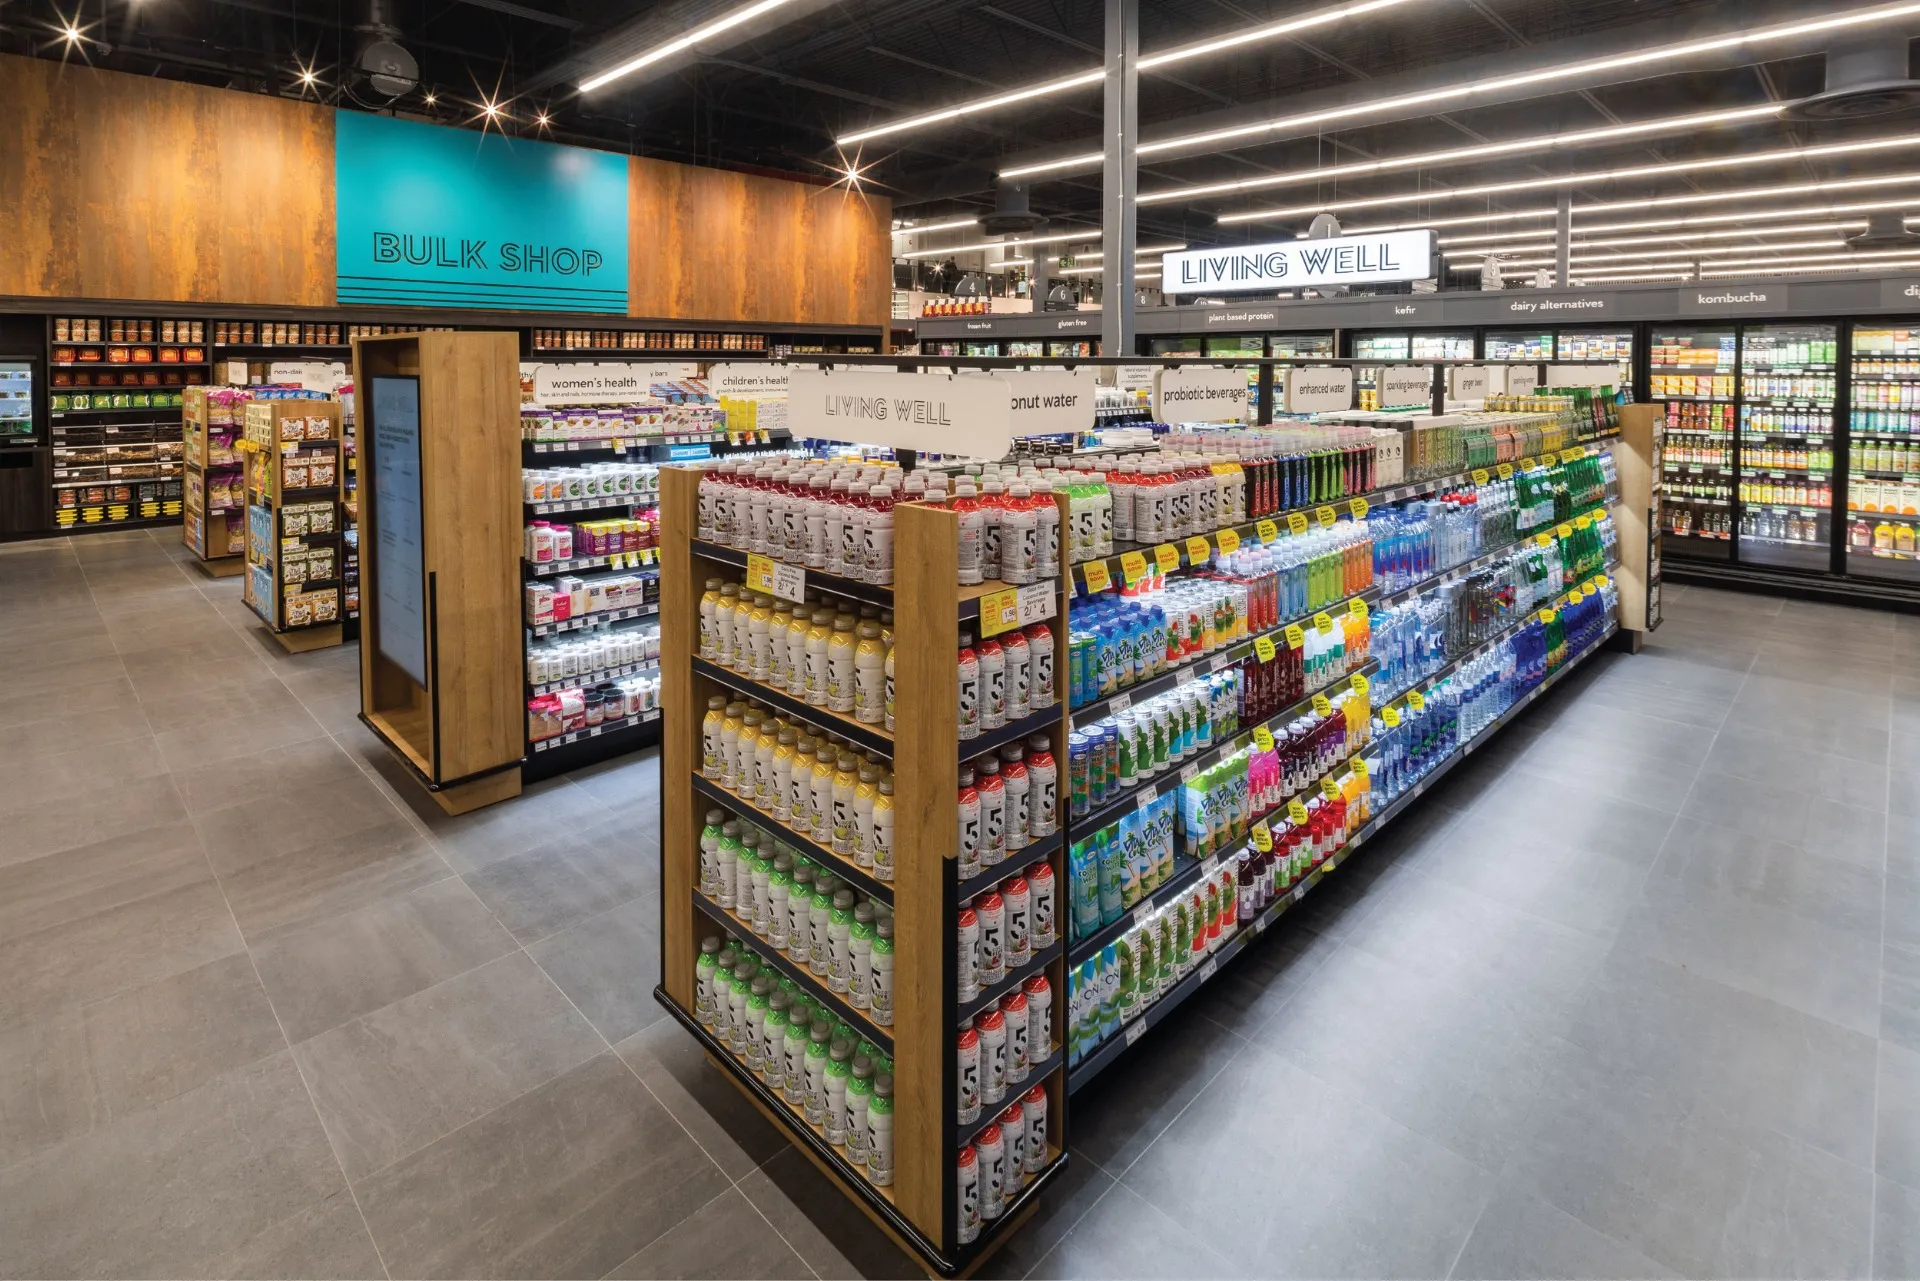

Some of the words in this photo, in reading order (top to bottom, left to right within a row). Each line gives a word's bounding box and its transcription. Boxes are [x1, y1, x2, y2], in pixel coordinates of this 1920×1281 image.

[374, 231, 488, 270] BULK
[499, 242, 602, 276] SHOP
[1182, 251, 1288, 284] LIVING
[1300, 244, 1400, 275] WELL
[969, 282, 975, 293] 4
[1060, 289, 1066, 300] 6
[1698, 291, 1767, 304] kombucha
[1208, 313, 1226, 323] plant
[1227, 312, 1247, 321] based
[1248, 311, 1274, 322] protein
[1395, 305, 1416, 315] kefir
[1510, 301, 1537, 313] dairy
[1539, 299, 1604, 310] alternatives
[1058, 320, 1075, 329] gluten
[1076, 319, 1088, 327] free
[551, 377, 602, 389] women's
[604, 377, 637, 387] health
[654, 370, 668, 378] bars
[722, 376, 764, 386] children's
[1386, 379, 1407, 393] sparkling
[1407, 379, 1428, 392] beverages
[1043, 393, 1078, 408] water
[1164, 386, 1204, 404] probiotic
[1205, 385, 1246, 403] beverages
[1299, 382, 1329, 395] enhanced
[1330, 383, 1346, 393] water
[825, 394, 888, 421] LIVING
[893, 399, 951, 426] WELL
[714, 499, 726, 520] 5
[1101, 507, 1112, 531] 5
[783, 513, 794, 537] 5
[1079, 512, 1092, 536] 5
[842, 524, 854, 550] 5
[985, 525, 1000, 552] 5
[1024, 529, 1036, 556] 5
[1190, 543, 1205, 551] multi
[1220, 536, 1235, 544] multi
[1125, 560, 1141, 568] multi
[1127, 565, 1143, 573] save
[1038, 654, 1051, 682] 5
[960, 681, 976, 711] 5
[990, 671, 1004, 700] 5
[1043, 782, 1055, 809] 5
[833, 800, 845, 827] 5
[988, 807, 1002, 836] 5
[964, 820, 978, 850] 5
[1035, 895, 1050, 922] 5
[1010, 911, 1026, 939] 5
[983, 928, 999, 956] 5
[1014, 1026, 1027, 1055] 5
[962, 1064, 977, 1095] 5
[1031, 1117, 1044, 1145] 5
[963, 1180, 977, 1213] 5
